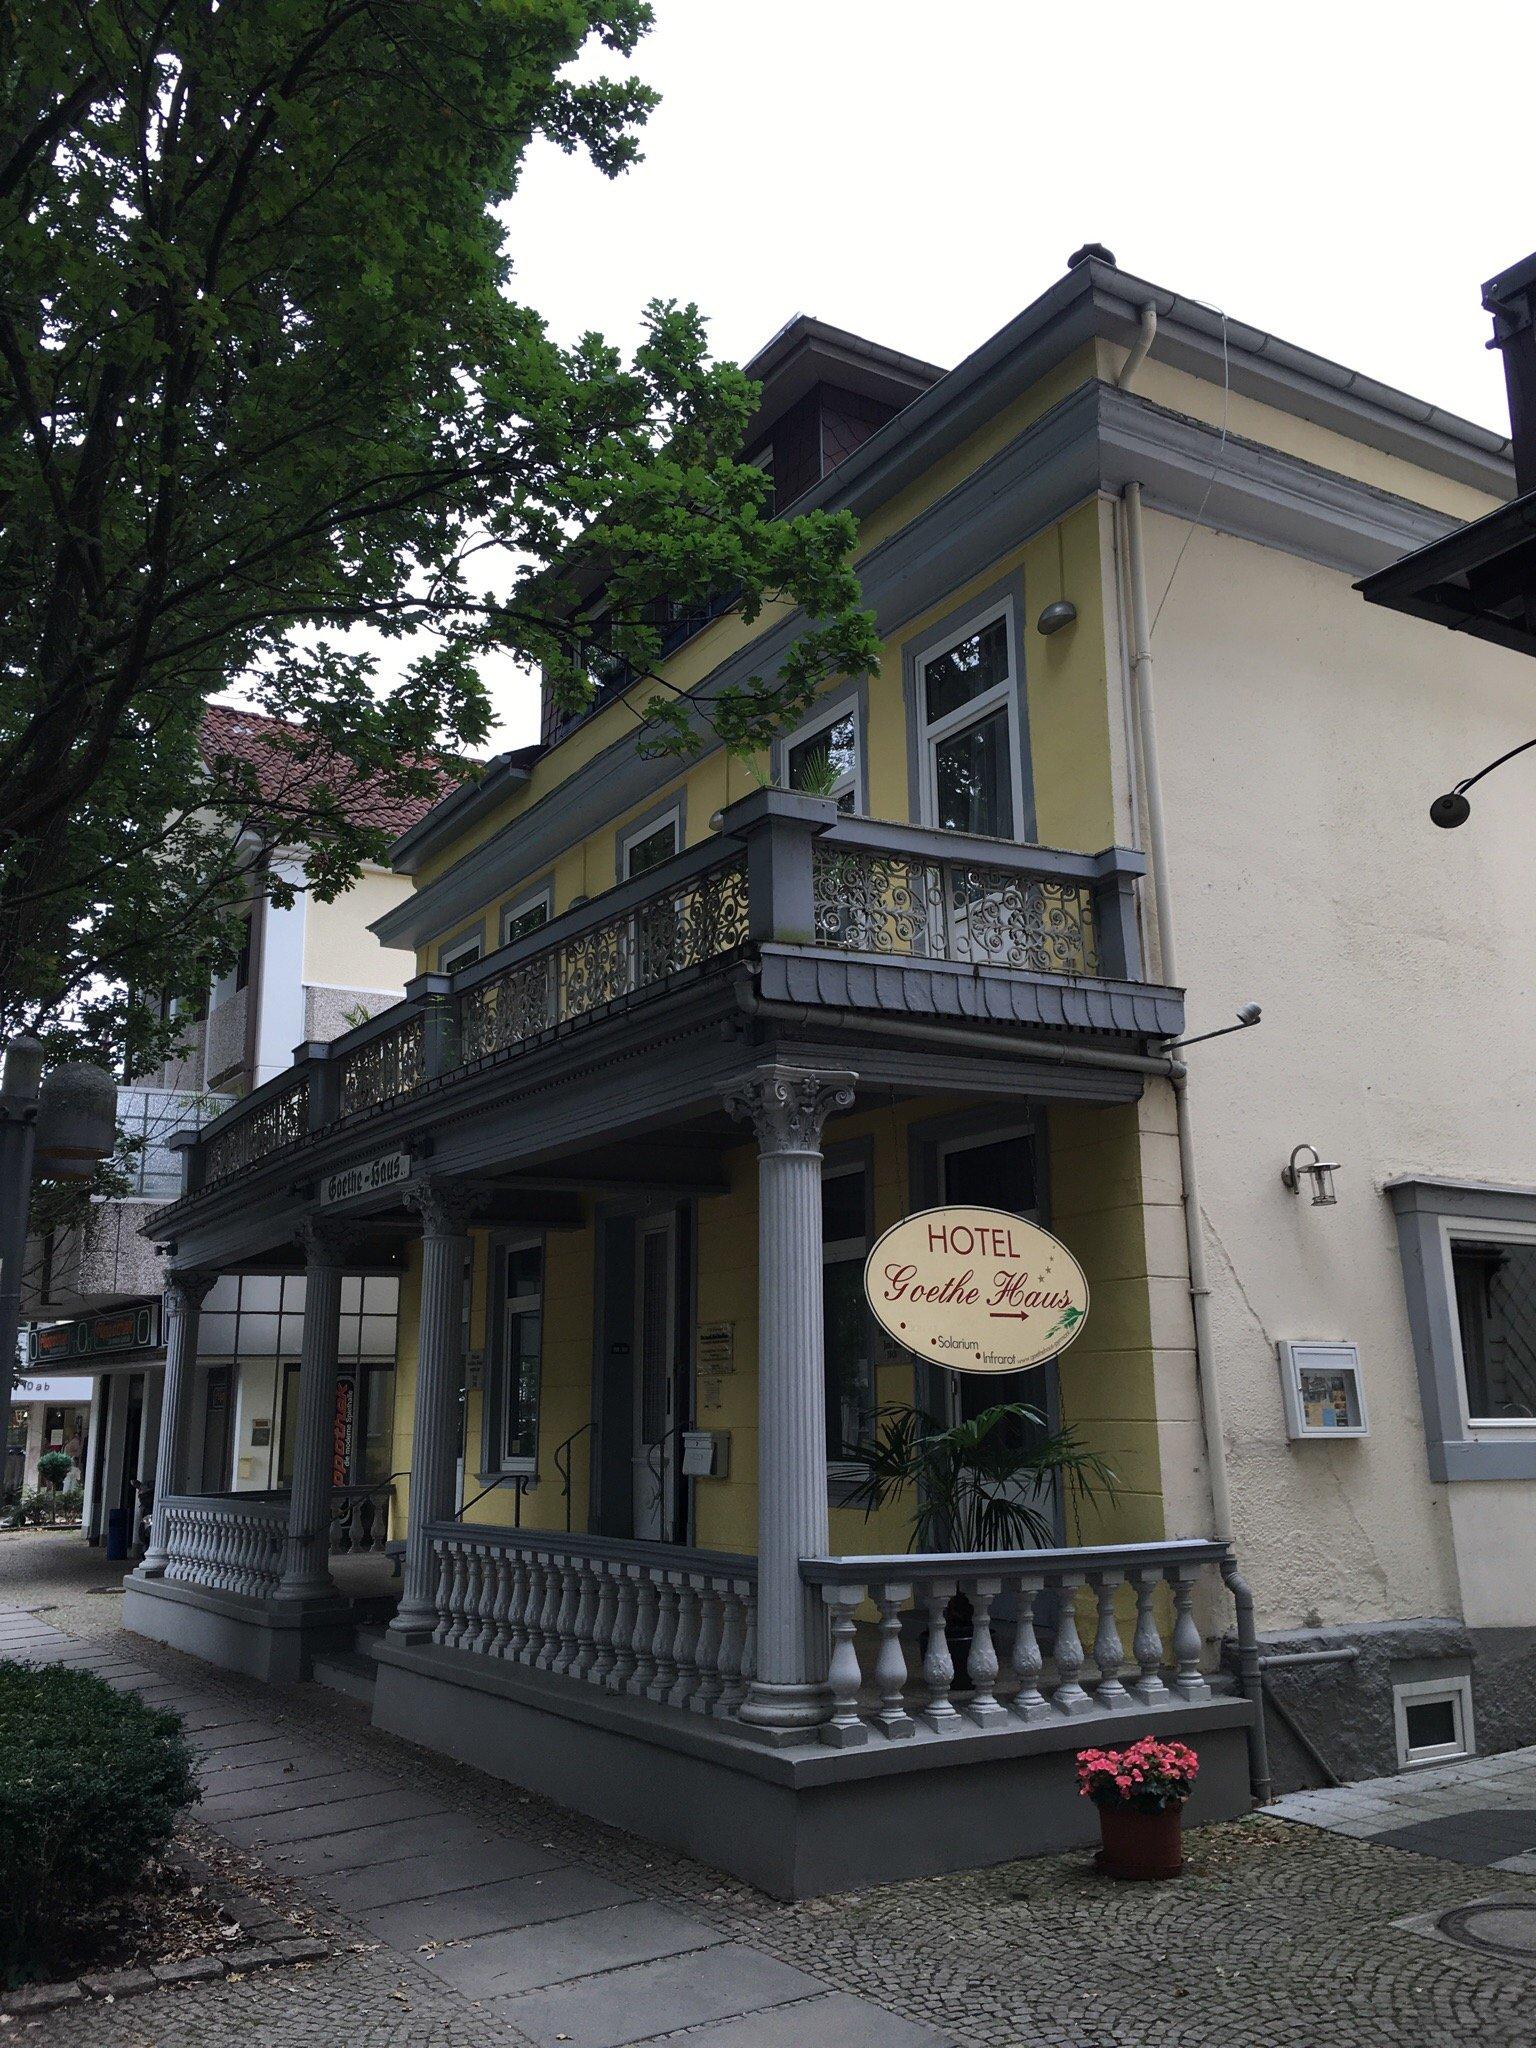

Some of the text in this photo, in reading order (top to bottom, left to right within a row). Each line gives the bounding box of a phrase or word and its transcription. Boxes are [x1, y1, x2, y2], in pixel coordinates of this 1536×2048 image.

[928, 1224, 1021, 1258] HOTEL
[884, 1263, 1073, 1308] Goethe Haus
[938, 1336, 979, 1350] Solarium
[983, 1351, 1016, 1365] Infrarot
